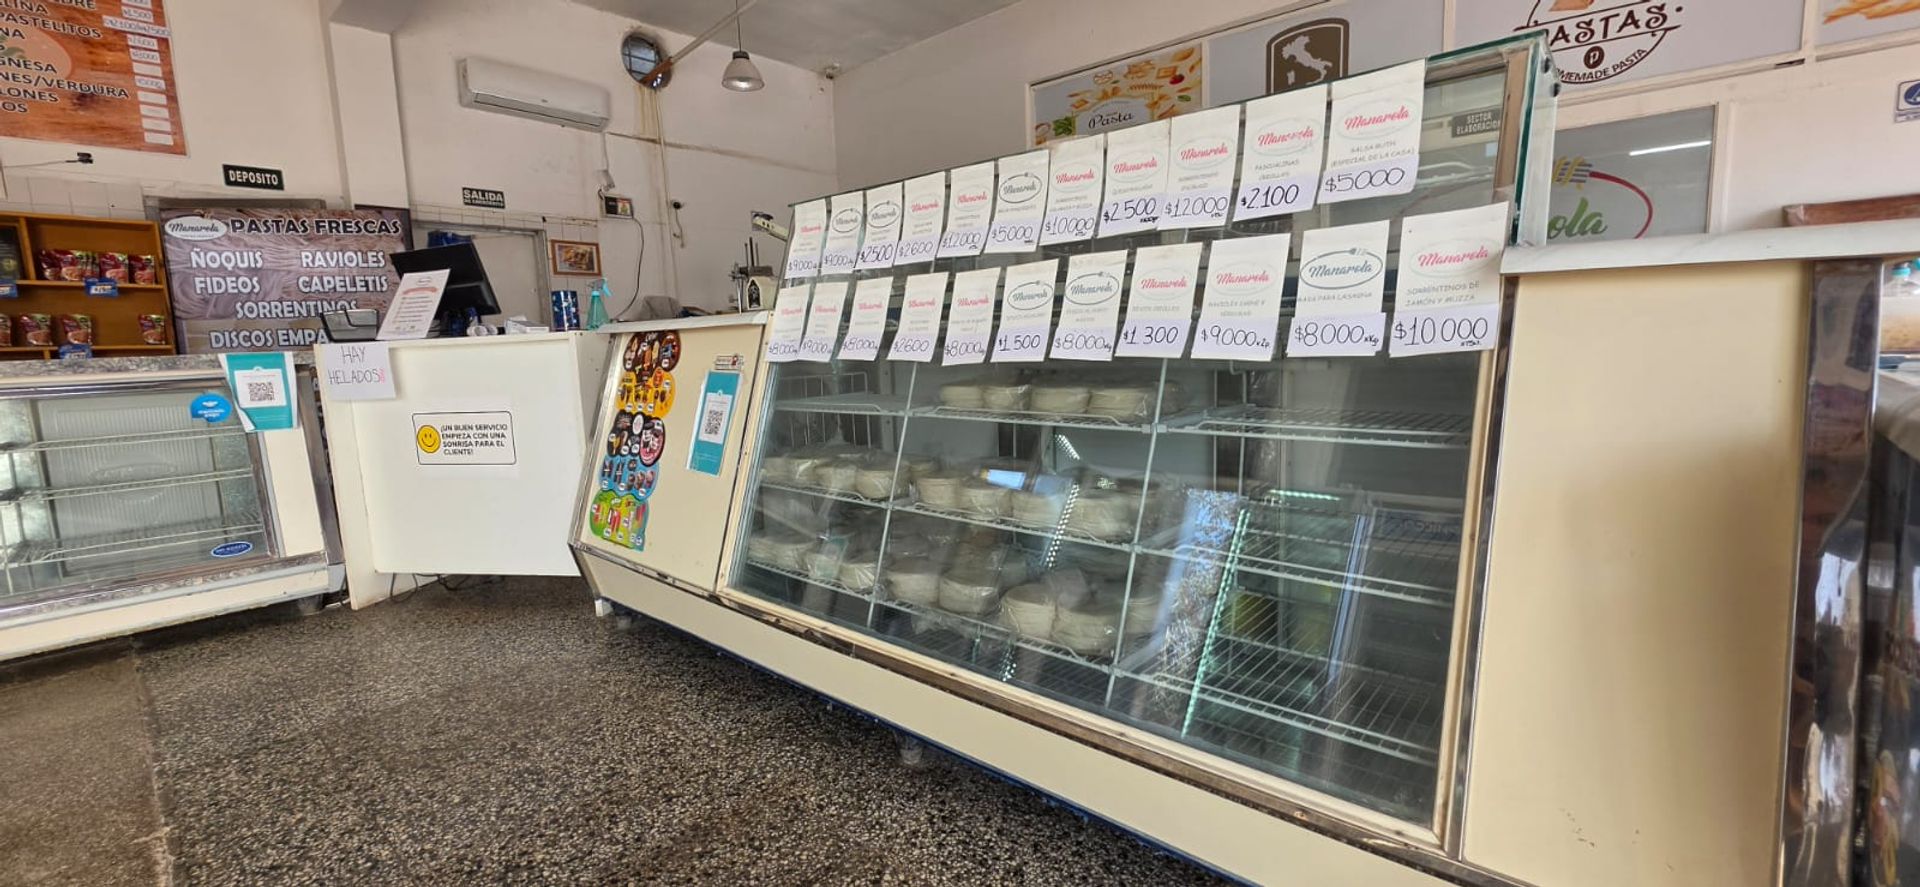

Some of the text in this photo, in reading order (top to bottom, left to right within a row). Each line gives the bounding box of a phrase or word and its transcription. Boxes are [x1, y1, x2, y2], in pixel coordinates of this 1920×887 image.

[0, 0, 48, 14] LINA
[1557, 48, 1647, 80] MEMADE PASTA
[1088, 112, 1134, 128] Pasta
[1344, 105, 1409, 130] Manarola
[1467, 112, 1491, 124] SECTOR
[229, 170, 278, 186] DEPOSITO
[1325, 167, 1405, 193] $5000
[464, 189, 503, 202] SALIDA
[1241, 184, 1300, 209] $2100
[1165, 196, 1228, 218] $12000
[230, 218, 308, 235] PASTAS
[314, 218, 400, 235] FRESCAS
[1045, 217, 1095, 235] $10000
[190, 248, 263, 270] ÑOQUIS
[301, 251, 386, 268] RAVIOLES
[1418, 245, 1488, 267] Manarola
[1308, 259, 1372, 278] Manarola
[194, 276, 261, 294] FIDEOS
[297, 276, 388, 293] CAPELETIS
[1407, 280, 1479, 295] SORRENTINOS DE
[210, 329, 273, 348] DISCOS
[1201, 325, 1257, 346] $9000
[1295, 322, 1364, 346] $8000
[341, 345, 366, 364] HAY
[442, 432, 471, 440] EMPIEZA
[475, 423, 508, 431] SERVICIO
[443, 440, 473, 448] SONRISA
